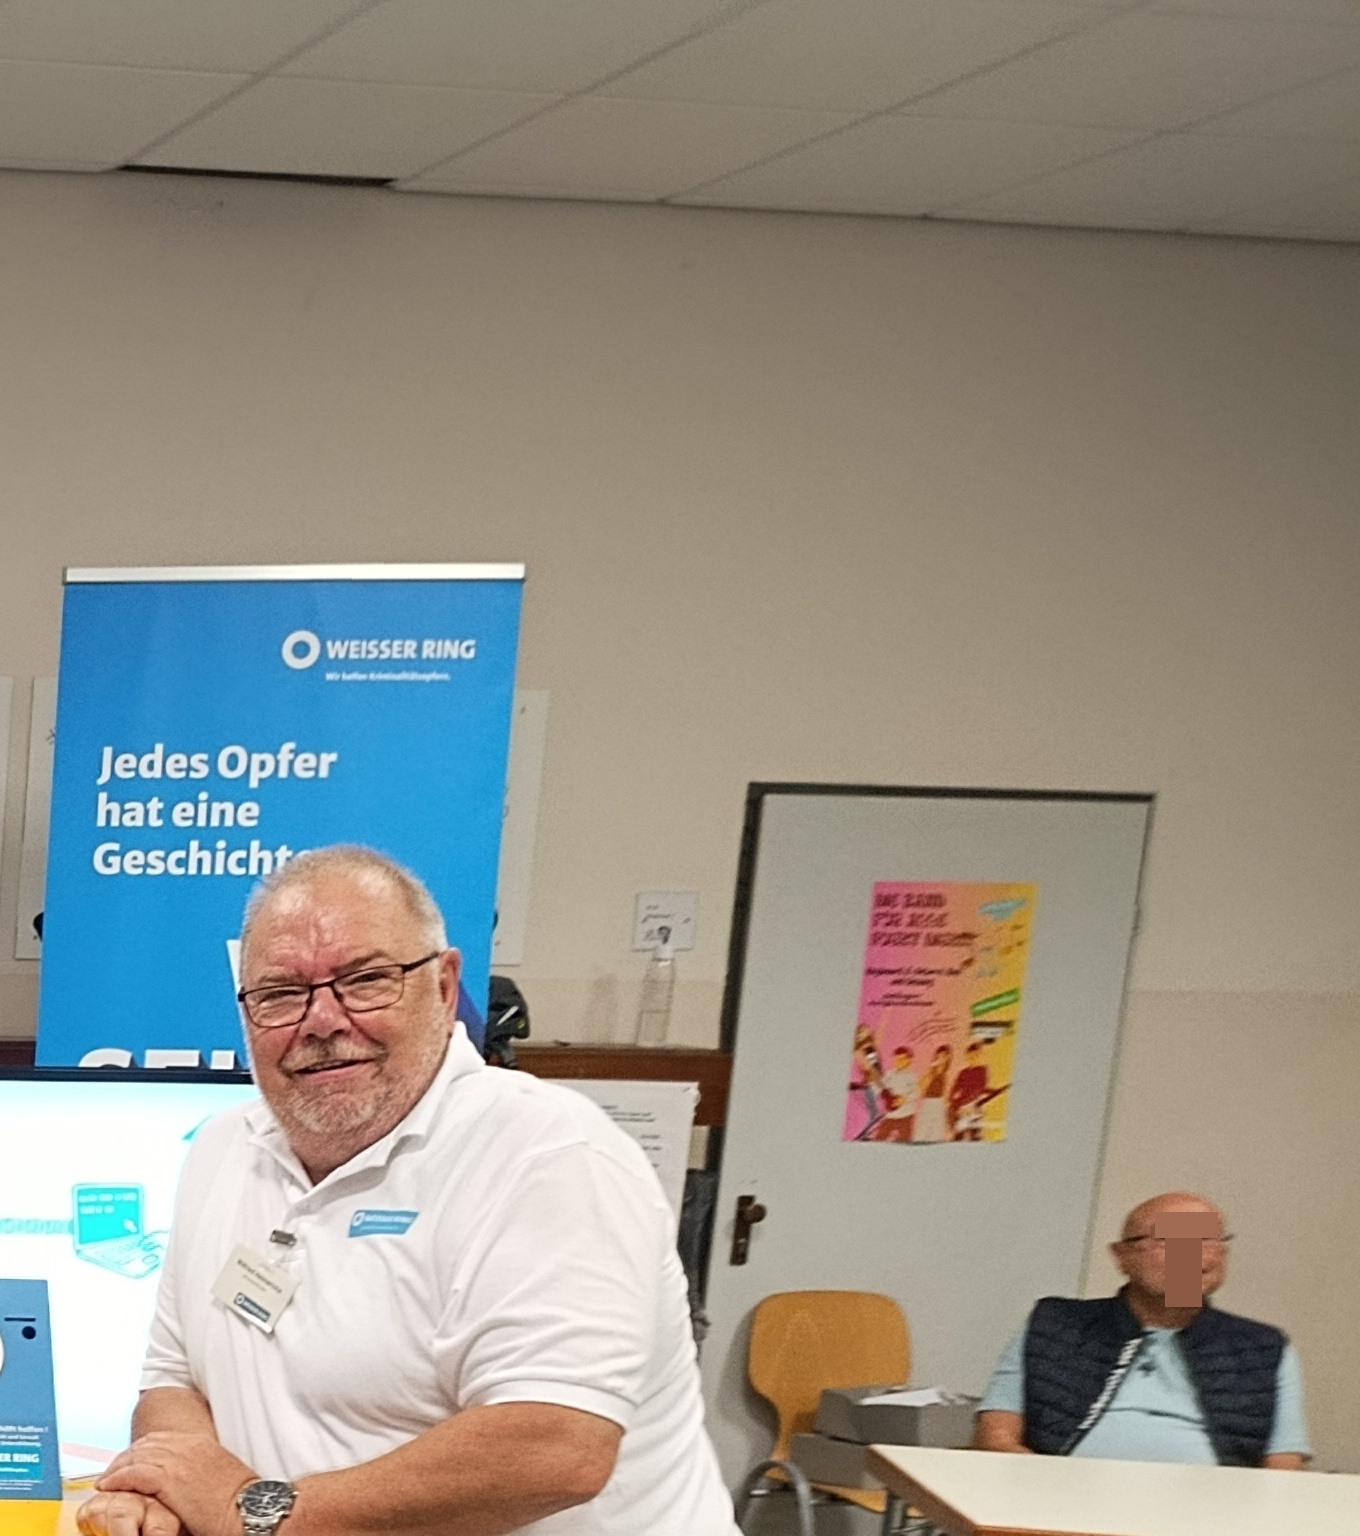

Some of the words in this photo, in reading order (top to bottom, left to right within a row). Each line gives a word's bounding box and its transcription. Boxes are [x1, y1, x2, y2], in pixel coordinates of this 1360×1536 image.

[326, 639, 418, 659] WEISSER
[422, 639, 477, 660] RING
[97, 743, 209, 786] Jedes
[217, 742, 337, 788] Opfer
[96, 793, 163, 827] hat
[172, 793, 260, 828] eine
[12, 1453, 40, 1463] RING
